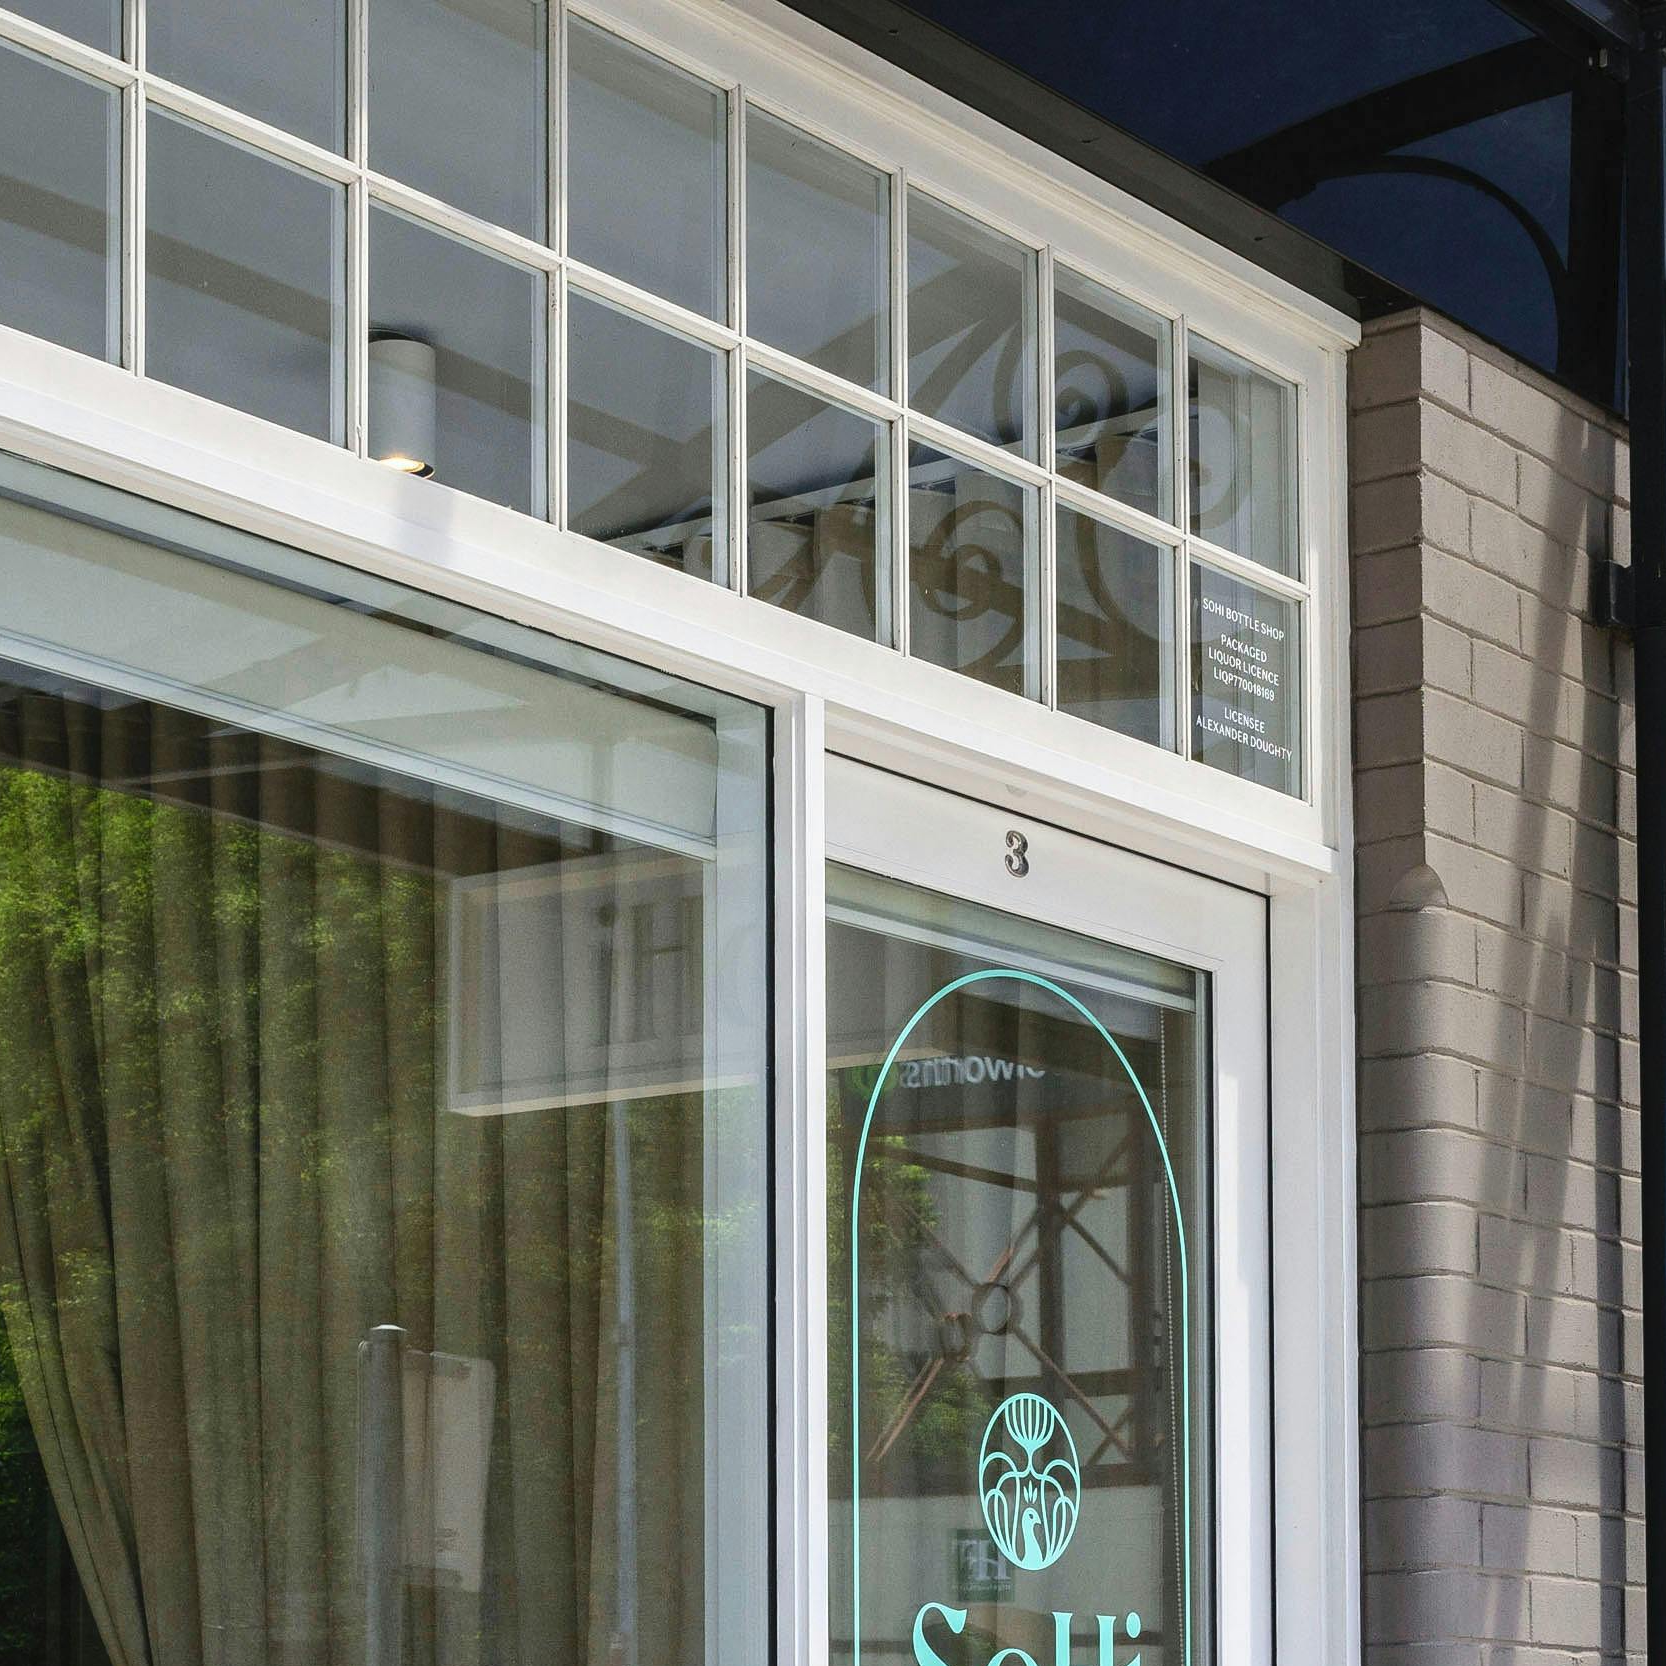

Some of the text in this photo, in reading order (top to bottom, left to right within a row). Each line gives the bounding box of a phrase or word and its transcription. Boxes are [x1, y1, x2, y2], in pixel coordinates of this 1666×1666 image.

[1203, 598, 1285, 640] SOHI BOTTLE SHOP
[1208, 646, 1279, 686] LIQUOR LICENCE
[1220, 633, 1267, 662] PACKAGED
[1213, 666, 1275, 701] LIQP770018169
[1196, 715, 1293, 761] ALEXANDER DOUGHTY
[1224, 706, 1265, 733] LICENSEE
[1005, 830, 1029, 878] 3
